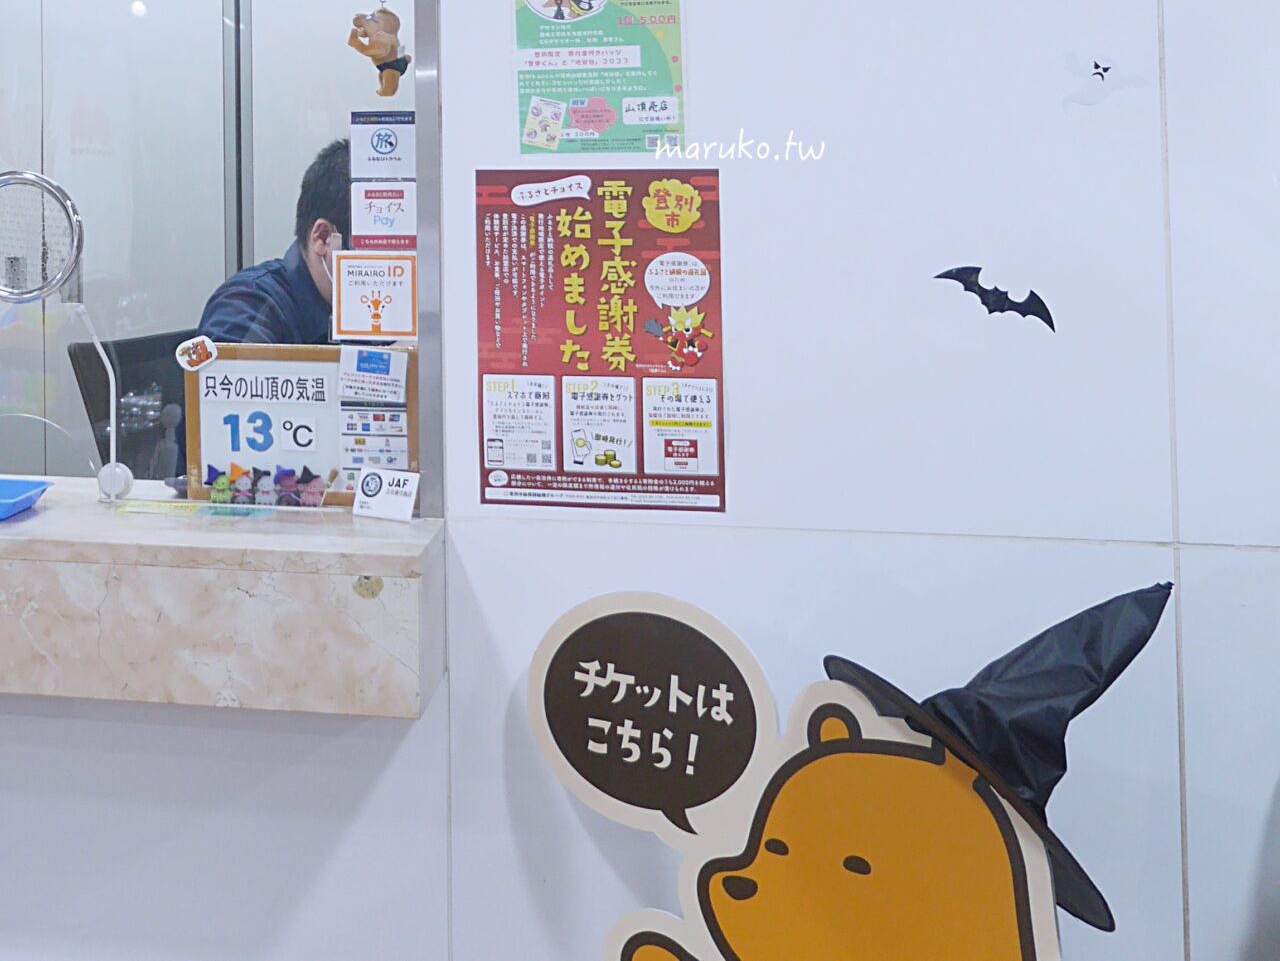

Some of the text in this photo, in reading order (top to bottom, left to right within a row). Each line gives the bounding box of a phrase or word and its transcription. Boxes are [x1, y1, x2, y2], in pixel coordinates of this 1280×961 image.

[519, 182, 584, 200] ふるさとチョイス
[652, 188, 695, 213] 登別
[365, 201, 405, 214] チョイス
[665, 211, 681, 229] 市
[373, 214, 396, 228] Pay
[347, 265, 405, 278] MIRAIRO ID
[597, 180, 638, 372] 電子感謝券
[555, 206, 593, 372] 始めました
[204, 374, 327, 402] 只今の山頂の気温
[223, 410, 274, 452] 13
[388, 477, 409, 488] JAF
[574, 659, 734, 726] チケットは
[587, 716, 700, 776] こちら!
